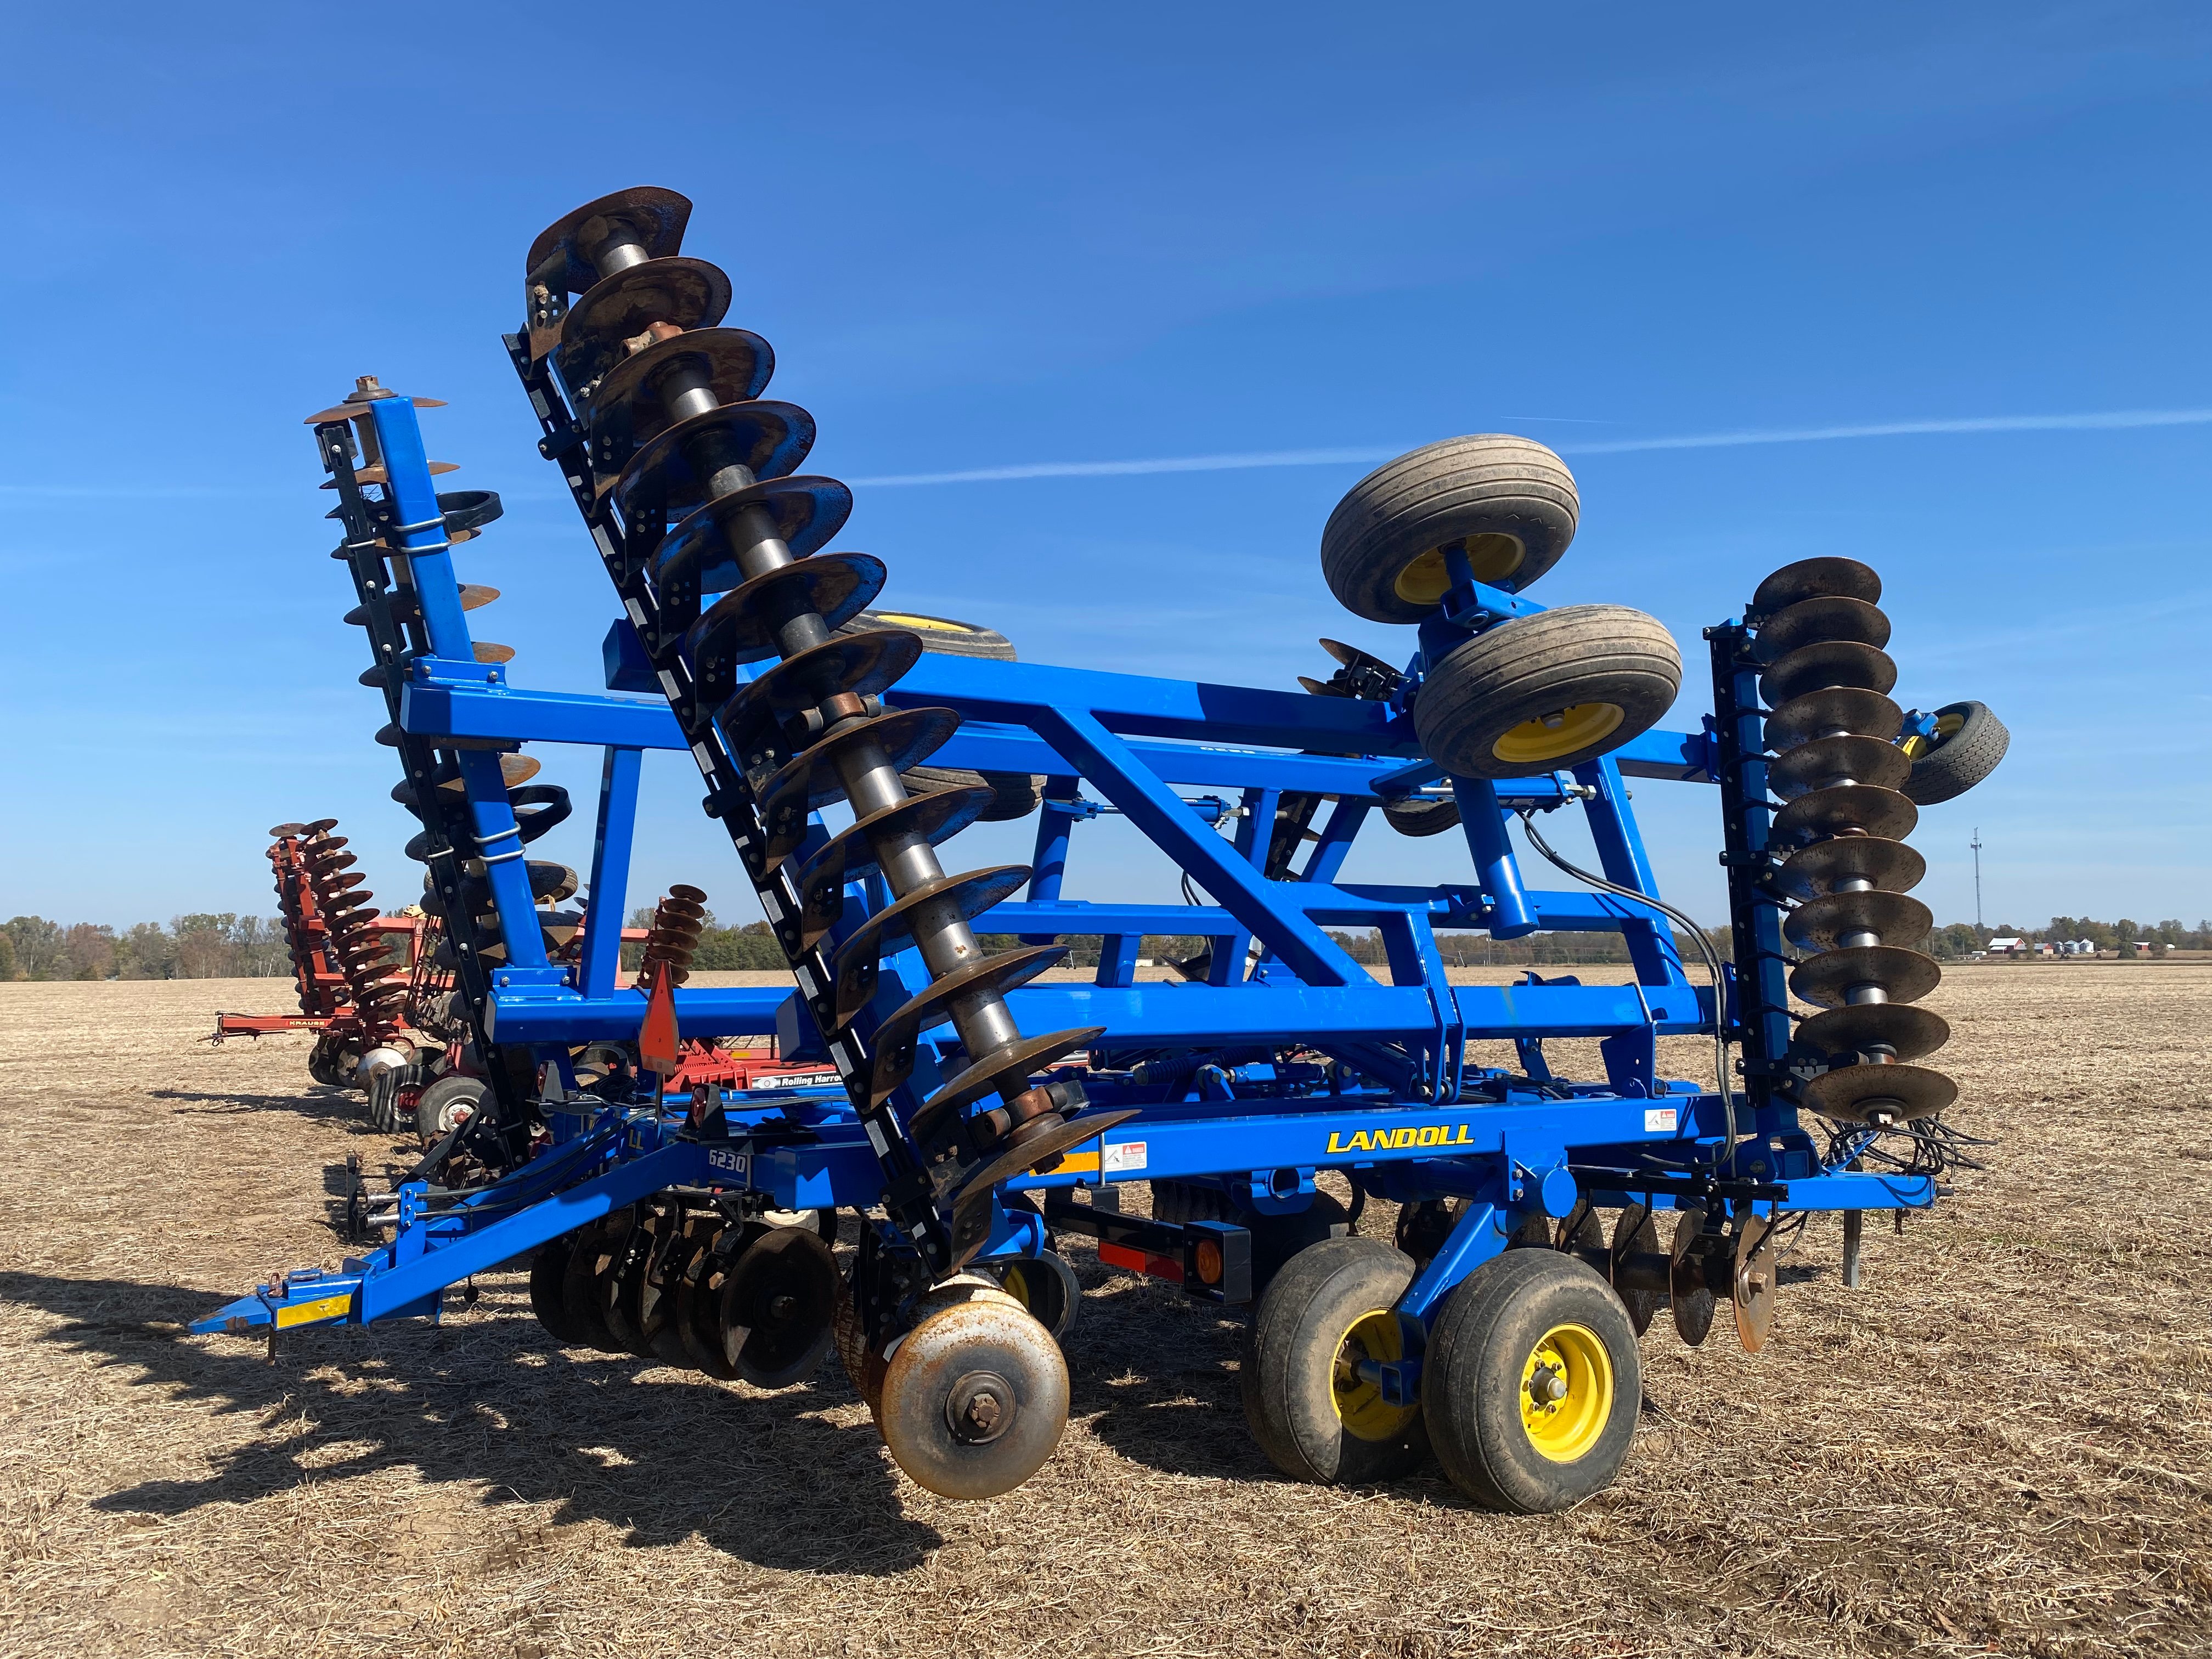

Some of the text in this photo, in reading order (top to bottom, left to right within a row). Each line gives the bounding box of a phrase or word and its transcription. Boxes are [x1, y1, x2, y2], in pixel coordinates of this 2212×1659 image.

[782, 1077, 812, 1086] Rolling
[1324, 1124, 1475, 1154] LANDOLL
[709, 1149, 746, 1173] 6230
